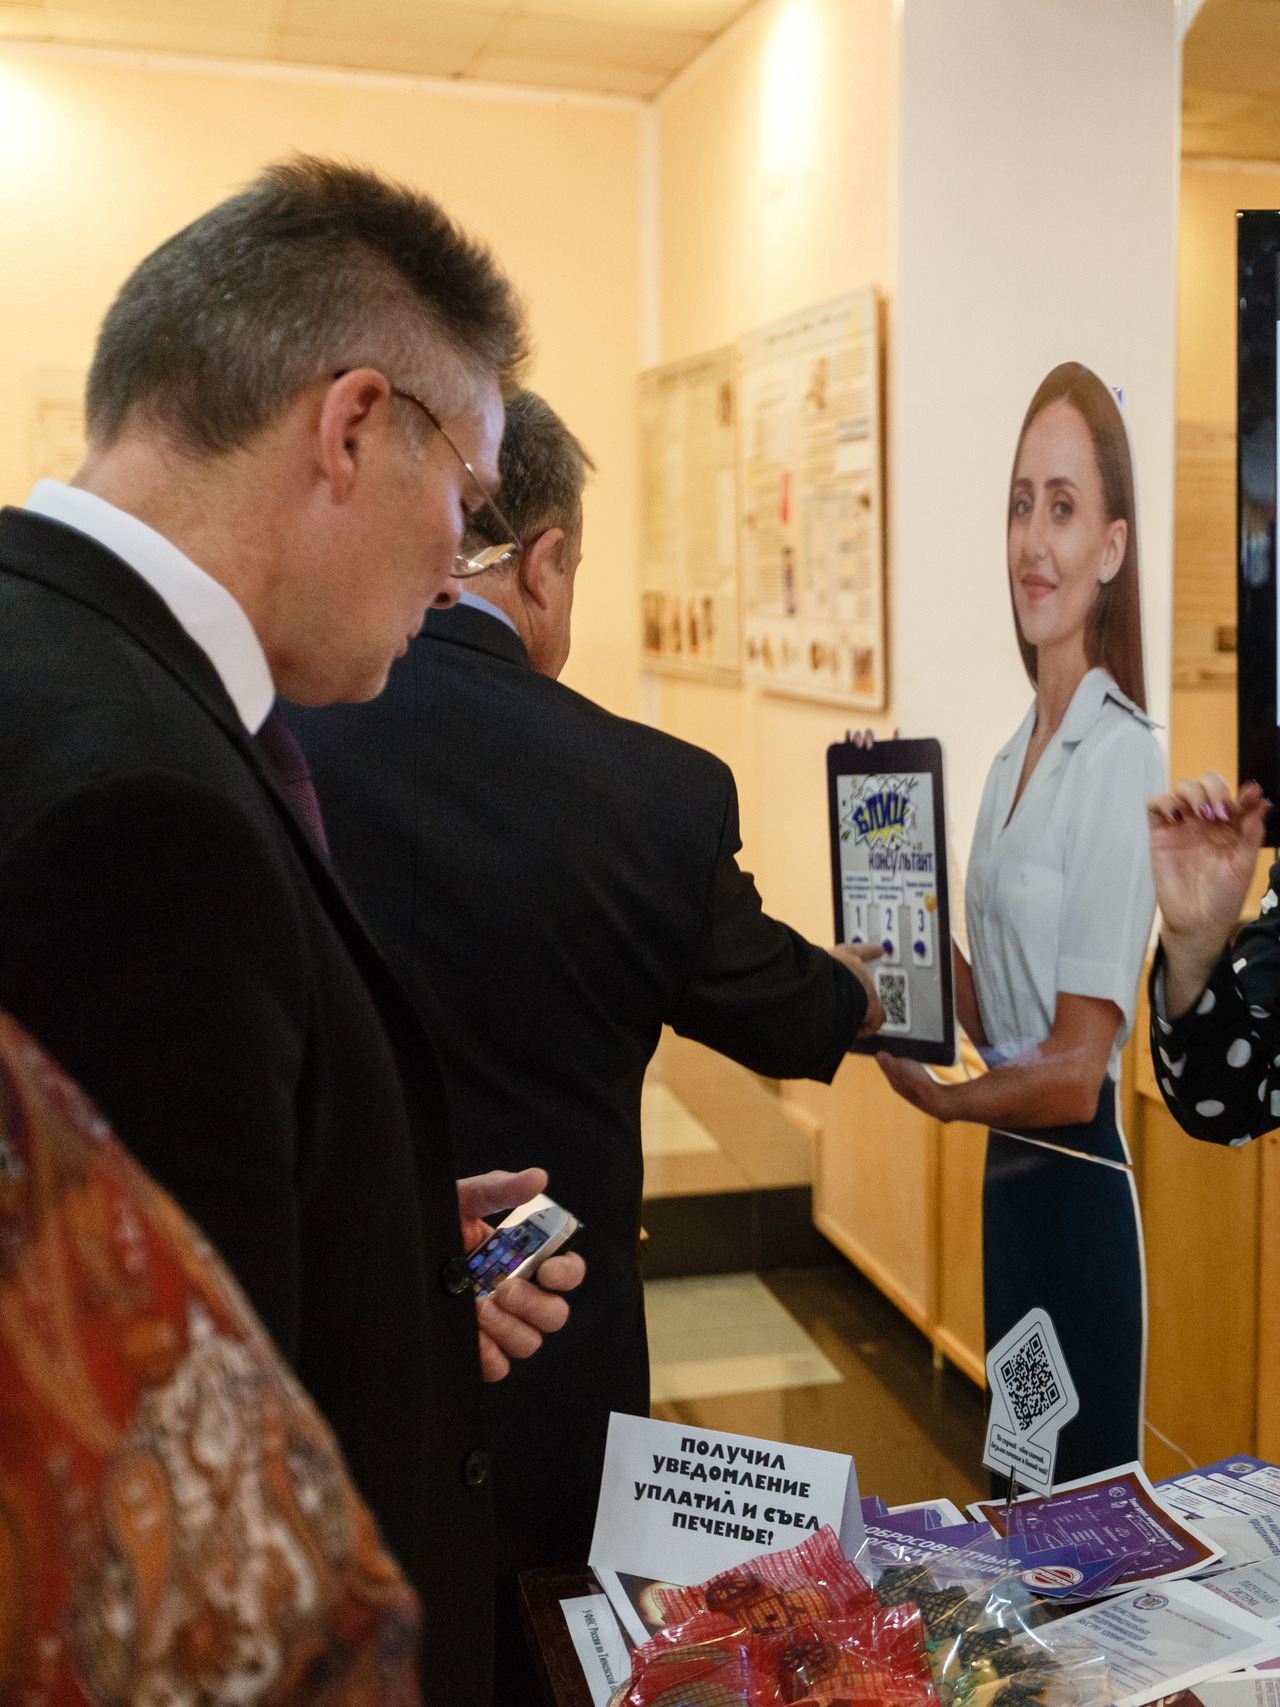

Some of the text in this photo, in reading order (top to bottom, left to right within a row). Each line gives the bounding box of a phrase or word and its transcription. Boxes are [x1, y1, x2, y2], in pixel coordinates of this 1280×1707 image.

[852, 790, 910, 835] БЛИЦ
[885, 907, 893, 931] 2
[917, 908, 925, 933] 3
[652, 1454, 811, 1499] УВЕДОМЛЕНИЕ
[680, 1437, 786, 1471] ПОЛУЧИЛ
[634, 1481, 821, 1532] УПЛАТИЛ И СЪЕЛ
[672, 1512, 775, 1547] ПЕЧЕНЬЕ!
[861, 1522, 1022, 1567] ОБРОСОВЕСТНЫЙ
